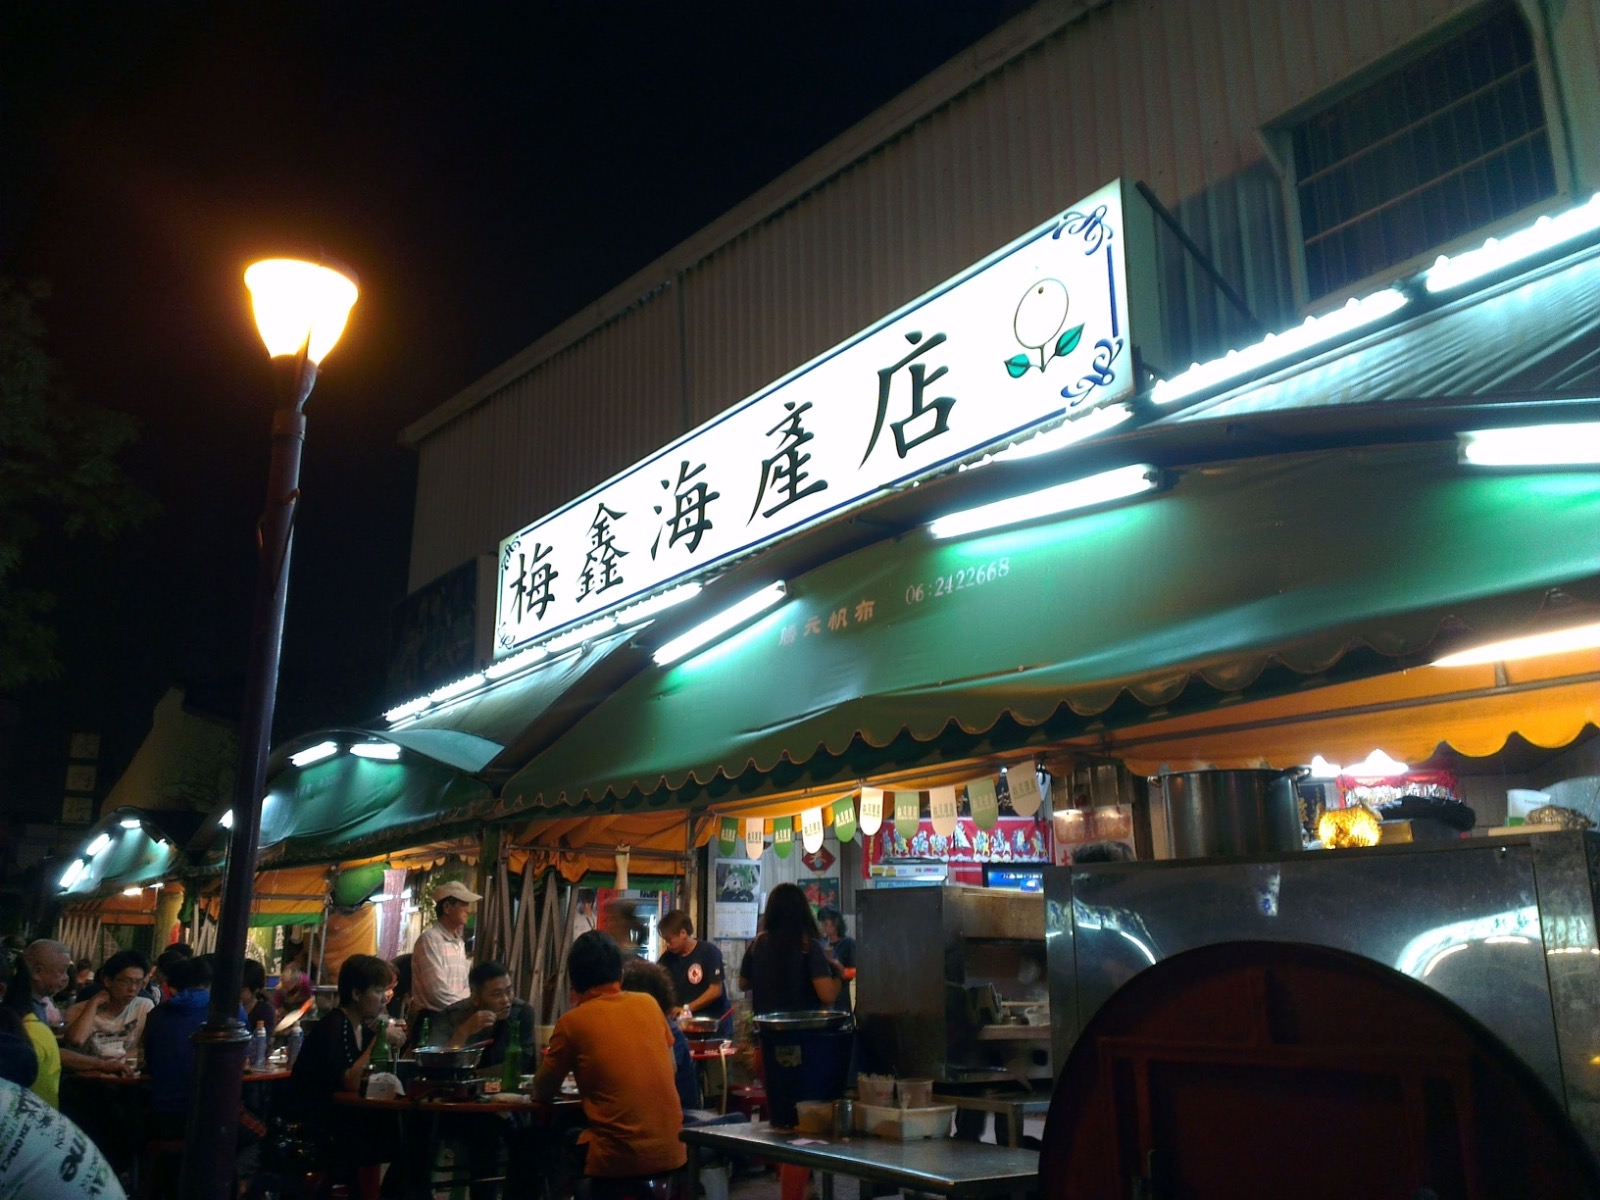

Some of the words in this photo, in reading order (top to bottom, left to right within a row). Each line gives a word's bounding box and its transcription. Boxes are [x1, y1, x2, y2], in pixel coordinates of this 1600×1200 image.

[509, 330, 957, 624] 梅鑫海產店
[905, 556, 1010, 605] 06:2422668
